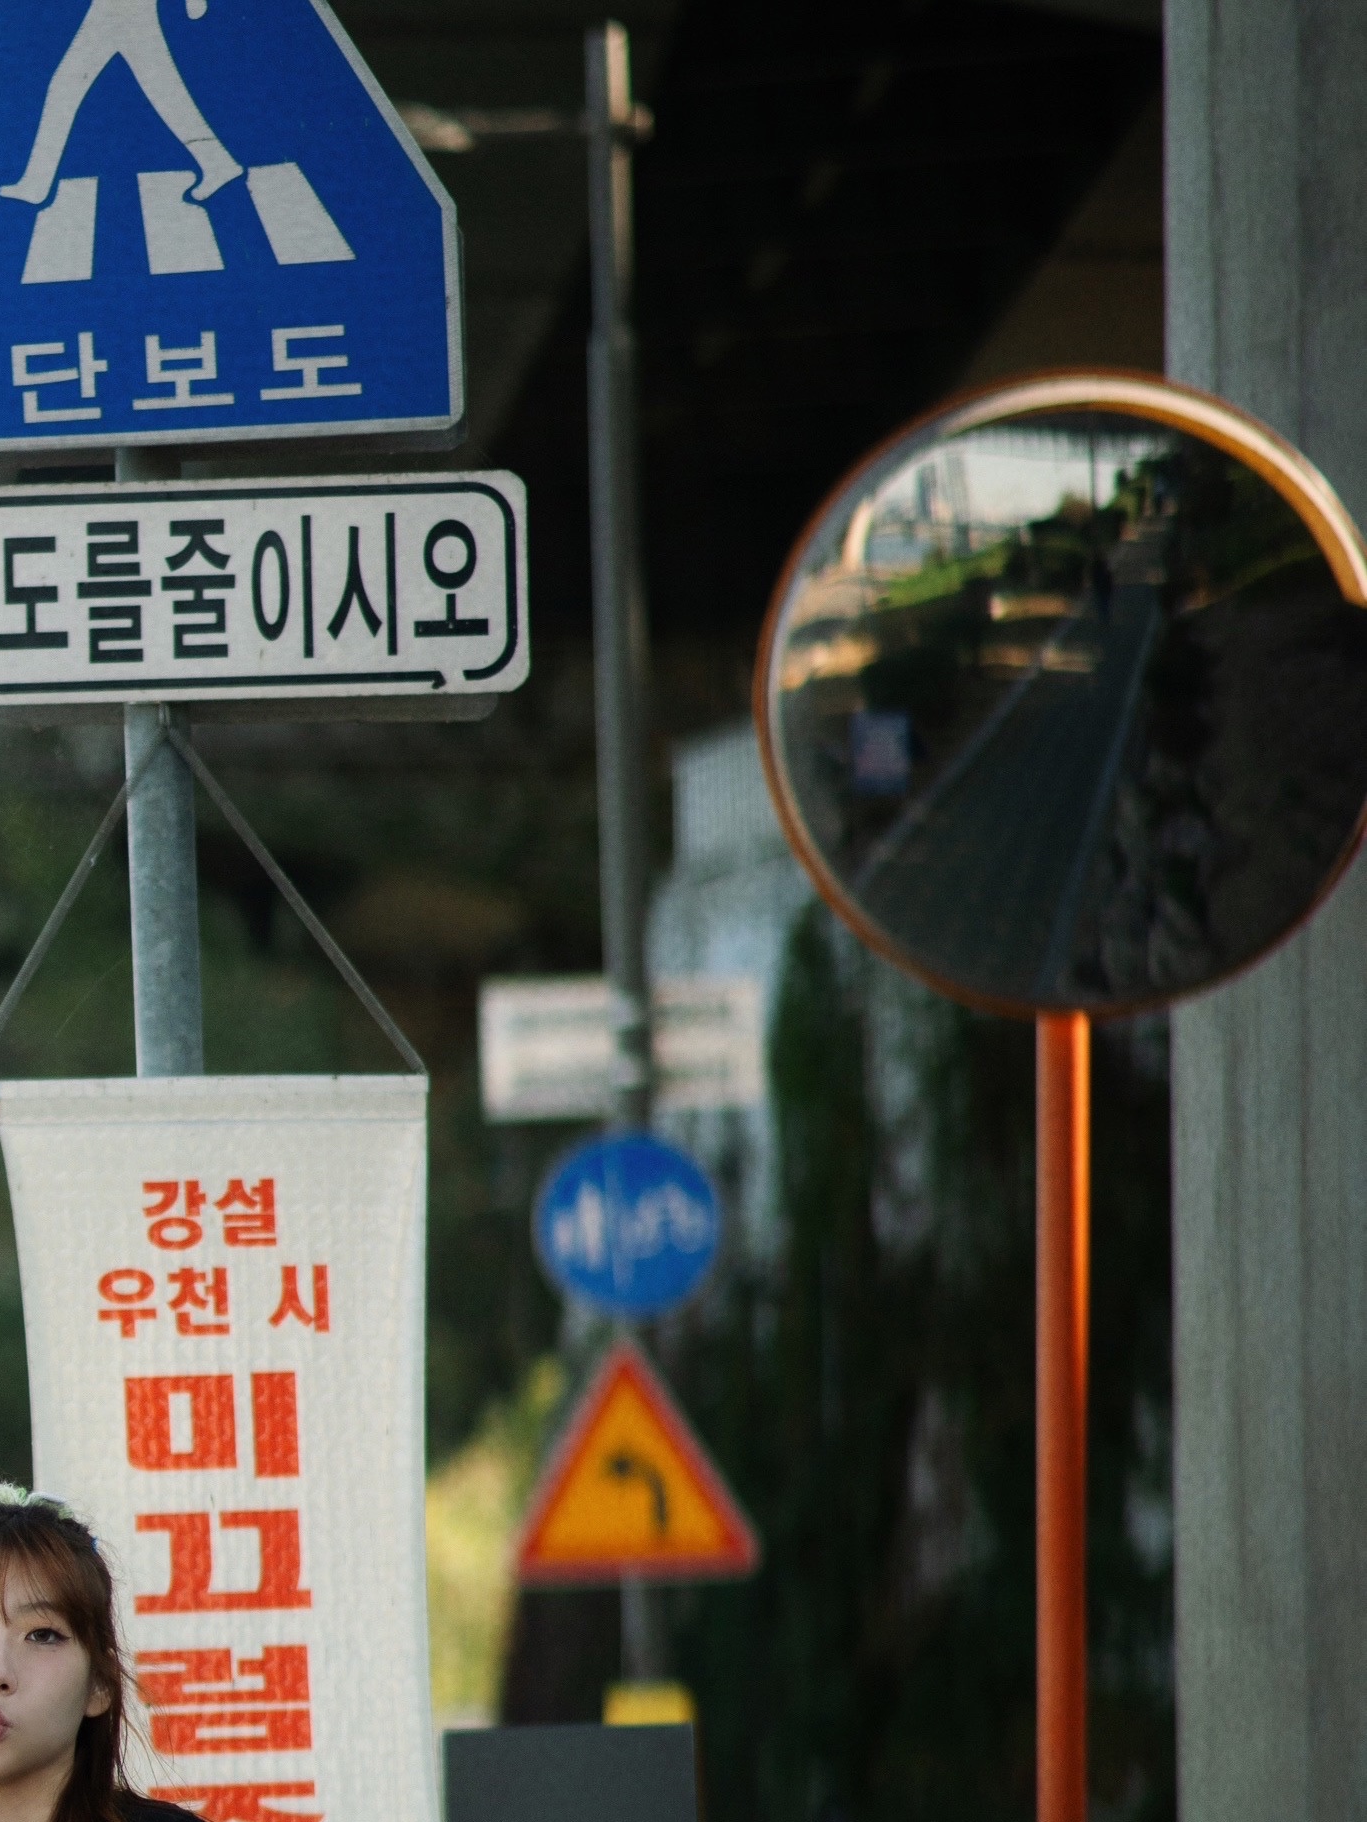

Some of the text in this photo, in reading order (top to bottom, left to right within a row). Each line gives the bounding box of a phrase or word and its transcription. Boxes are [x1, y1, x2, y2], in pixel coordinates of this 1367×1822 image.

[142, 1178, 278, 1251] 강설
[97, 1264, 331, 1339] 우천 시
